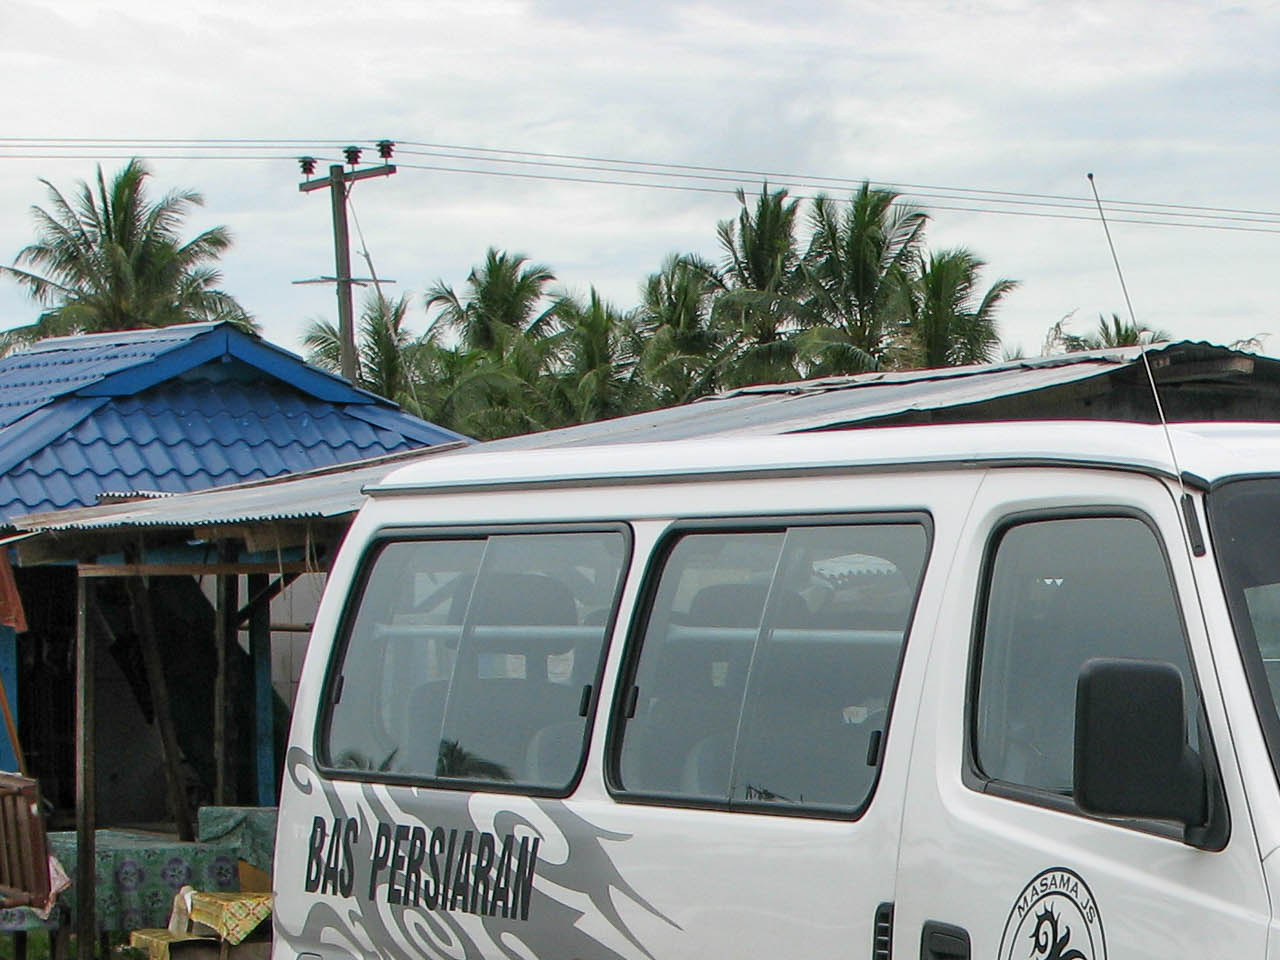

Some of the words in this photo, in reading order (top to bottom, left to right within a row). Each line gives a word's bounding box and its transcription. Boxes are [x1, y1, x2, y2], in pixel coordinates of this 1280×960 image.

[305, 816, 358, 898] BAS
[369, 822, 540, 921] PERSIARAN
[1017, 873, 1079, 919] MASAMA
[1080, 898, 1096, 925] JS
